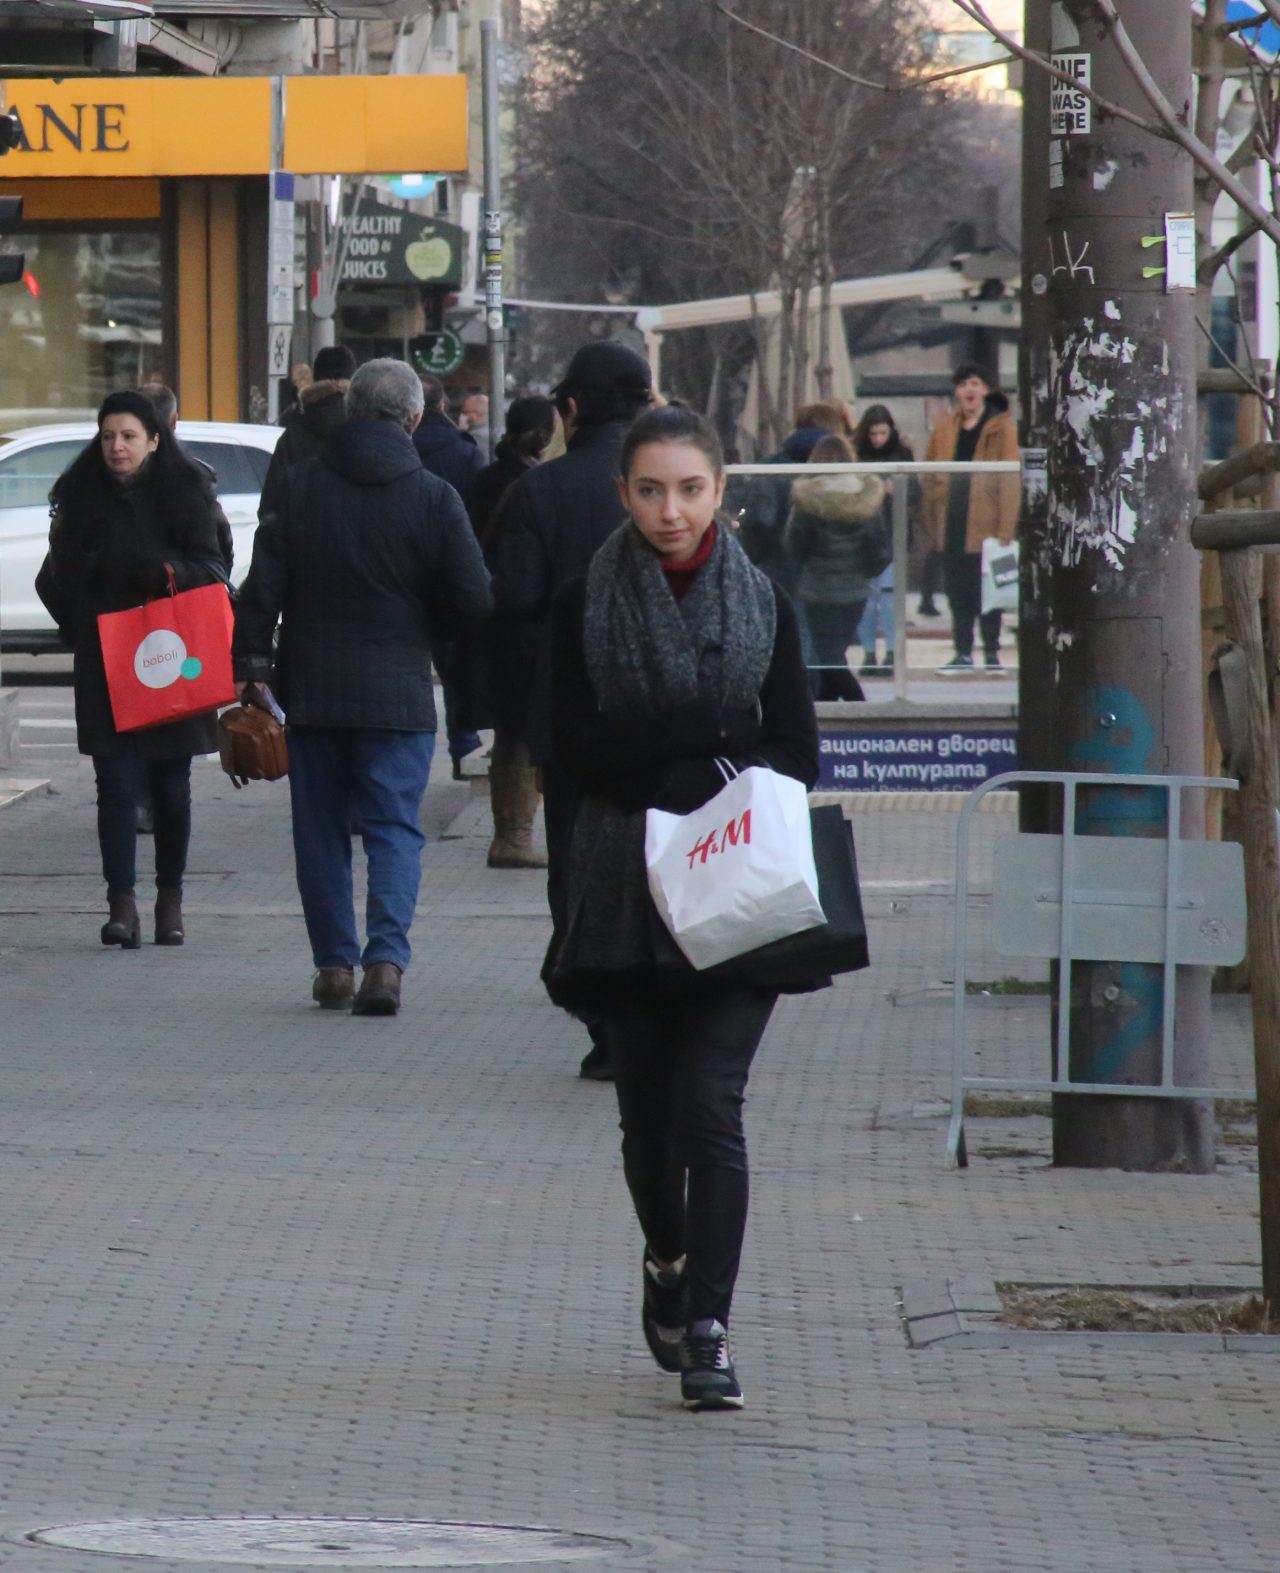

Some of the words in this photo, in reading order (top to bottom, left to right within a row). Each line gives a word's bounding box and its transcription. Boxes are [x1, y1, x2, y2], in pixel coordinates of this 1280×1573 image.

[1052, 93, 1086, 110] WAS
[342, 260, 388, 279] JUICES
[820, 737, 933, 755] ационален
[937, 734, 1017, 757] дворец
[834, 764, 858, 778] на
[863, 760, 988, 783] културата
[685, 808, 752, 870] H&M
